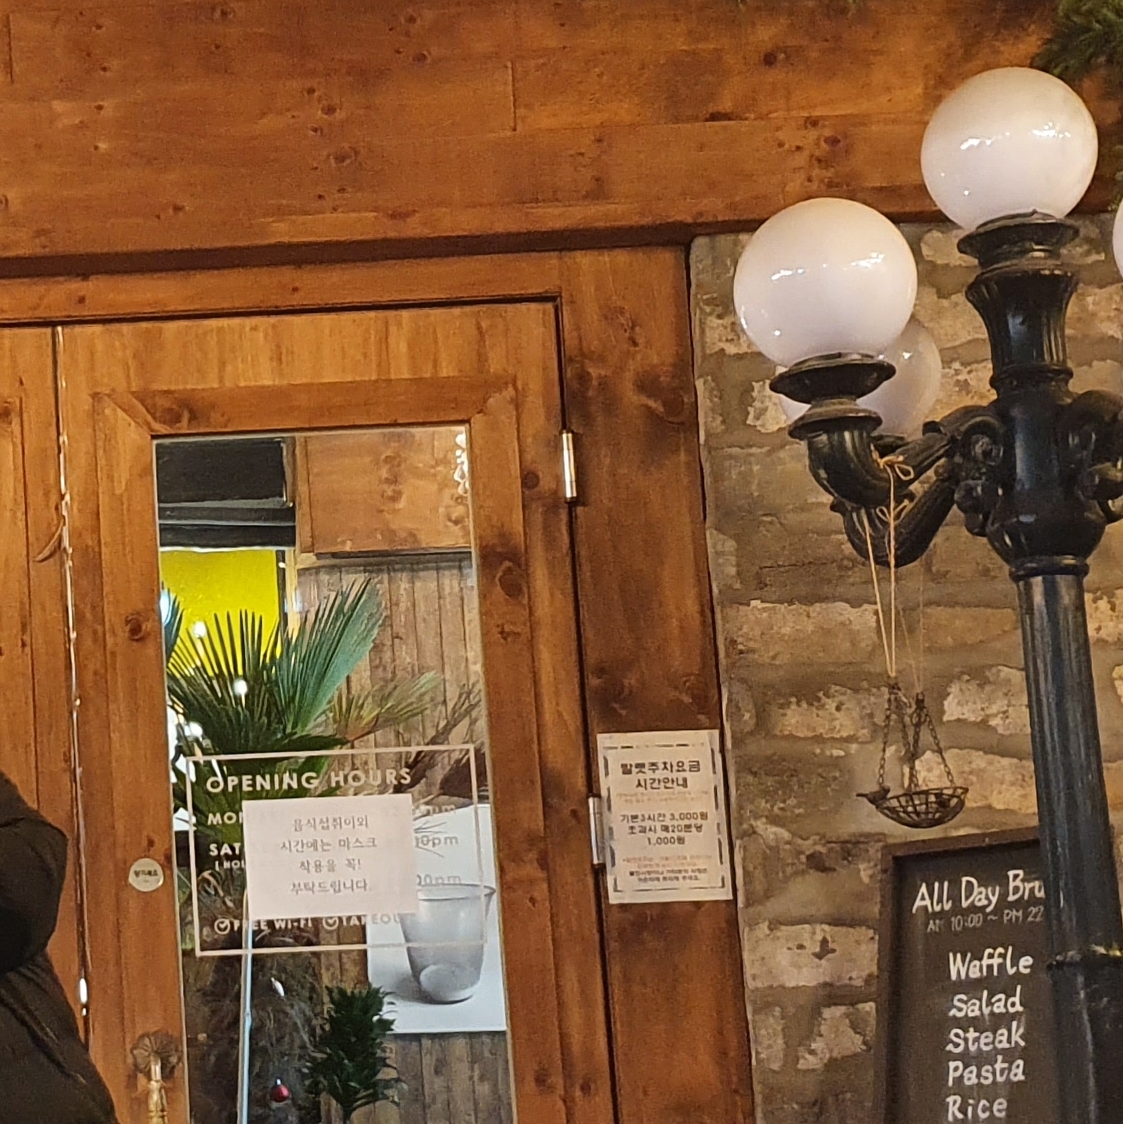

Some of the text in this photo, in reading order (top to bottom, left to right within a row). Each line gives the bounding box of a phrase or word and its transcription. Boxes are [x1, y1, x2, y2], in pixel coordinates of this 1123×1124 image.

[620, 760, 701, 775] 발렛주차요금
[206, 768, 412, 793] OPENING HOURS
[635, 777, 689, 790] 시간안내
[293, 815, 368, 832] 음식섭취이외
[209, 842, 242, 857] SAT
[280, 837, 377, 853] 시간에는 마스크
[299, 859, 337, 874] 착용을
[912, 880, 952, 914] All
[961, 876, 999, 913] Day
[951, 913, 983, 932] 10:00
[1003, 908, 1023, 925] PM
[948, 945, 1033, 981] Waffle
[948, 984, 1024, 1018] Salad
[945, 1020, 1025, 1053] Steak
[948, 1054, 1025, 1087] Pasta
[946, 1095, 1008, 1122] Rice
